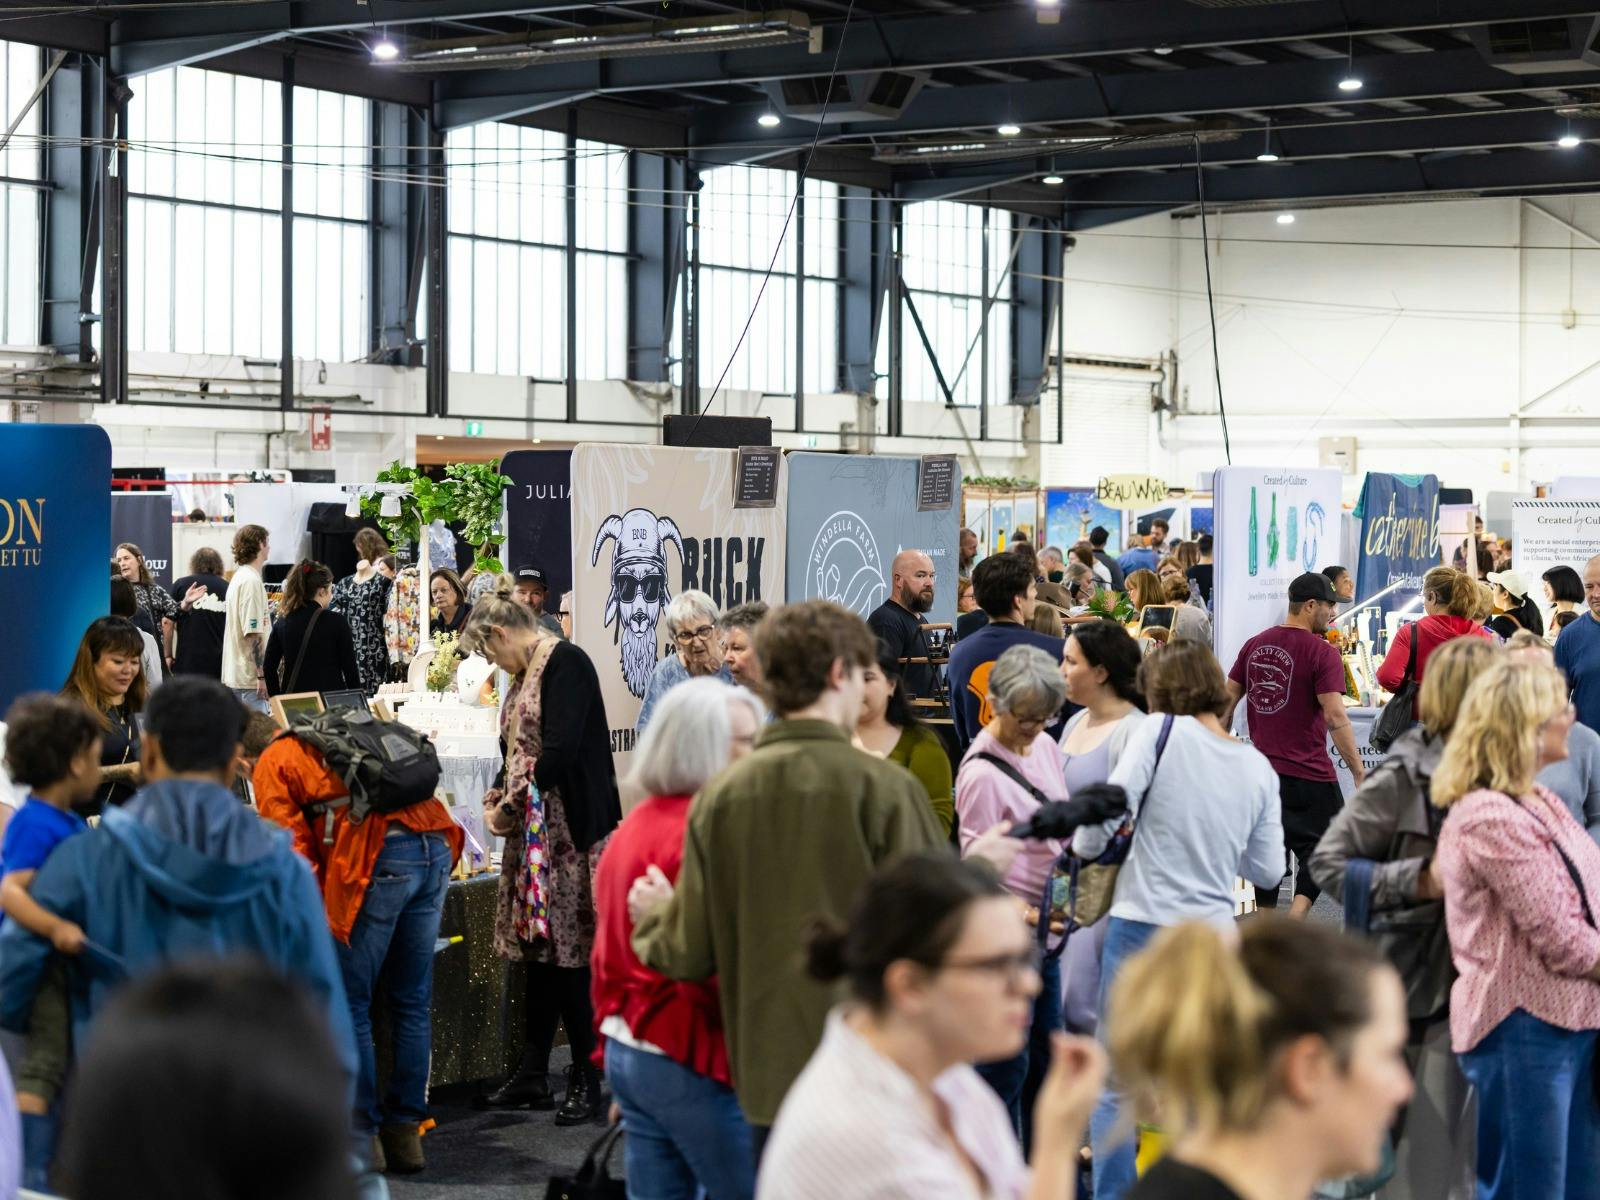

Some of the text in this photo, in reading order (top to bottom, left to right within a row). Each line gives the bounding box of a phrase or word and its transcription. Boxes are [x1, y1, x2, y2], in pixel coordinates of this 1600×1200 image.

[1097, 477, 1132, 502] BEAU
[1365, 492, 1428, 561] catherine
[1537, 515, 1573, 525] Created
[814, 519, 875, 564] WINDELLA FARM
[23, 548, 42, 566] TU
[681, 536, 766, 612] BUCK
[1252, 647, 1275, 660] SALTY
[1274, 650, 1291, 666] CREW
[609, 728, 641, 753] STRA
